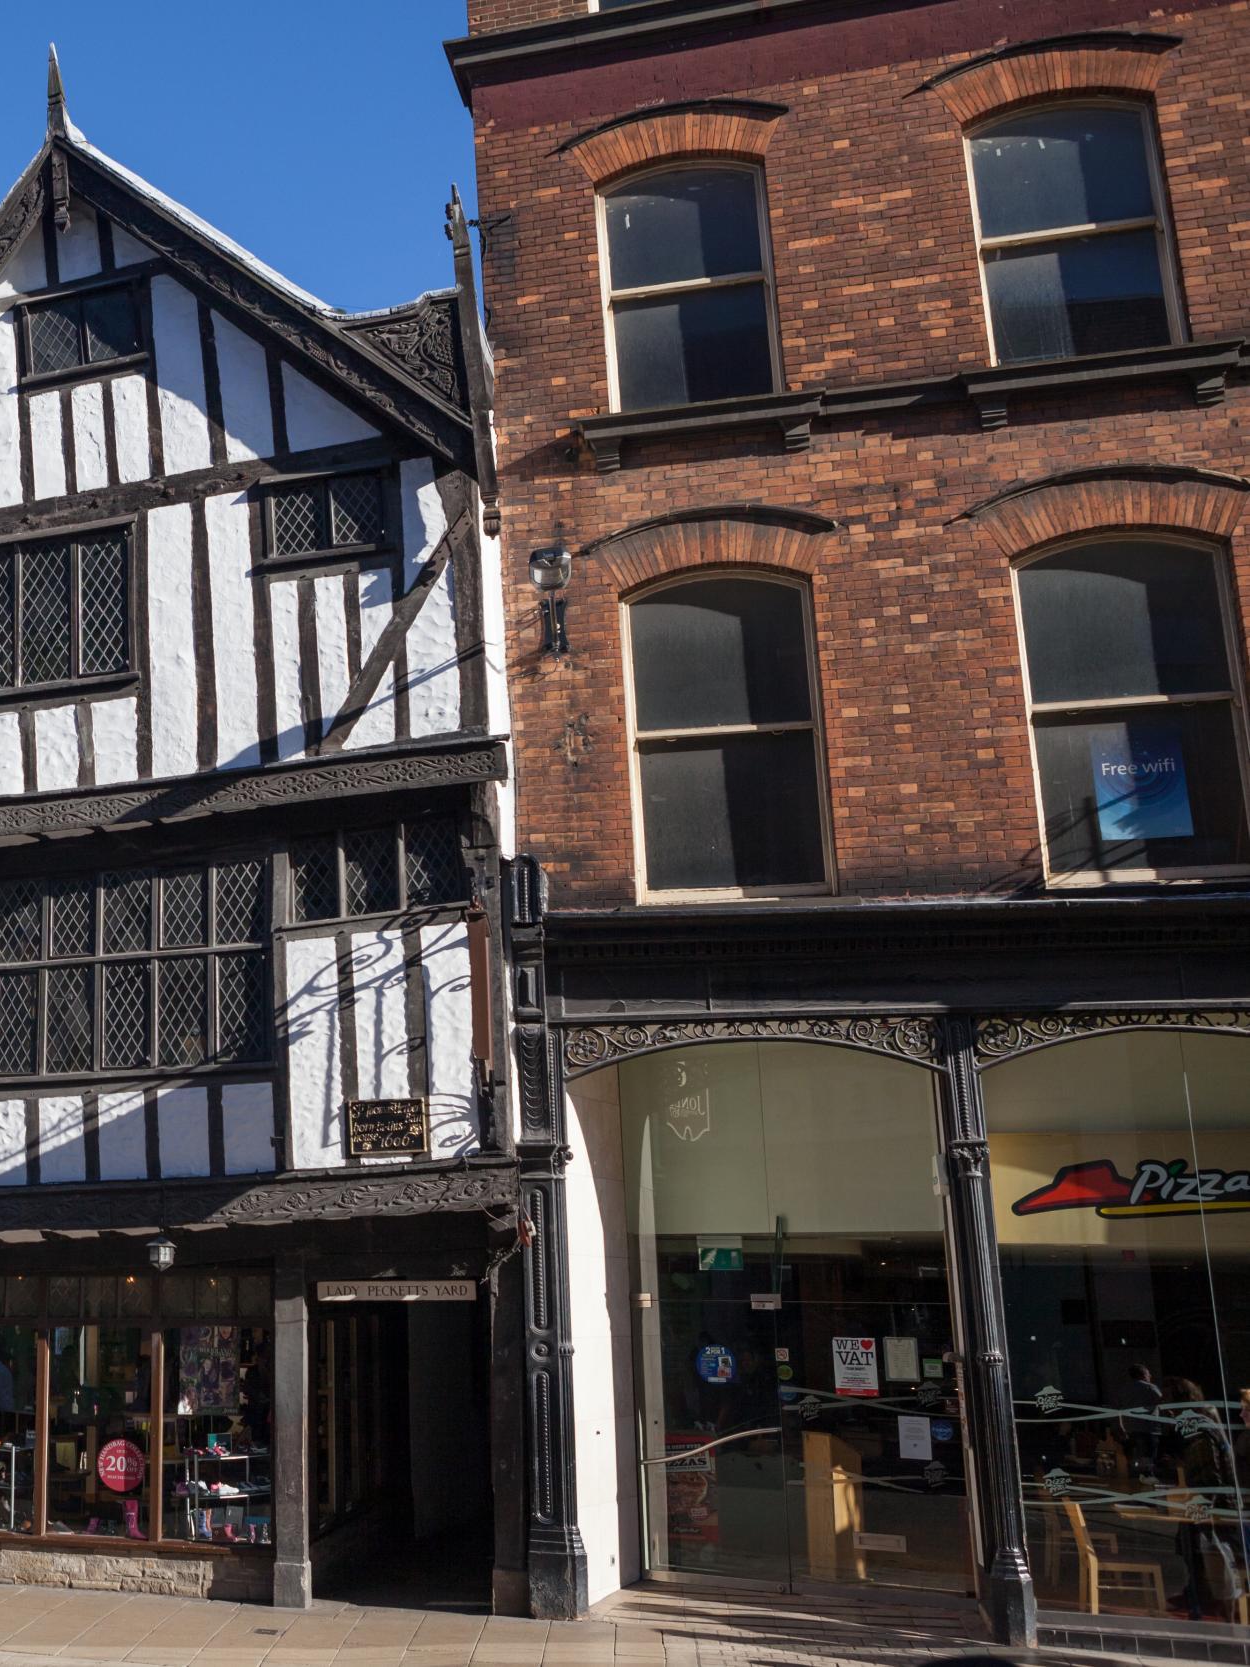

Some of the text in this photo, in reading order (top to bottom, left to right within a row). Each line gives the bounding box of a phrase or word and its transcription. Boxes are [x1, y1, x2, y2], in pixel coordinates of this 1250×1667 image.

[1101, 758, 1175, 776] Free wifi
[1130, 1163, 1250, 1204] Pizza
[326, 1285, 360, 1297] LADY
[434, 1285, 468, 1297] YARD
[835, 1340, 859, 1350] WE
[836, 1351, 874, 1366] VAT
